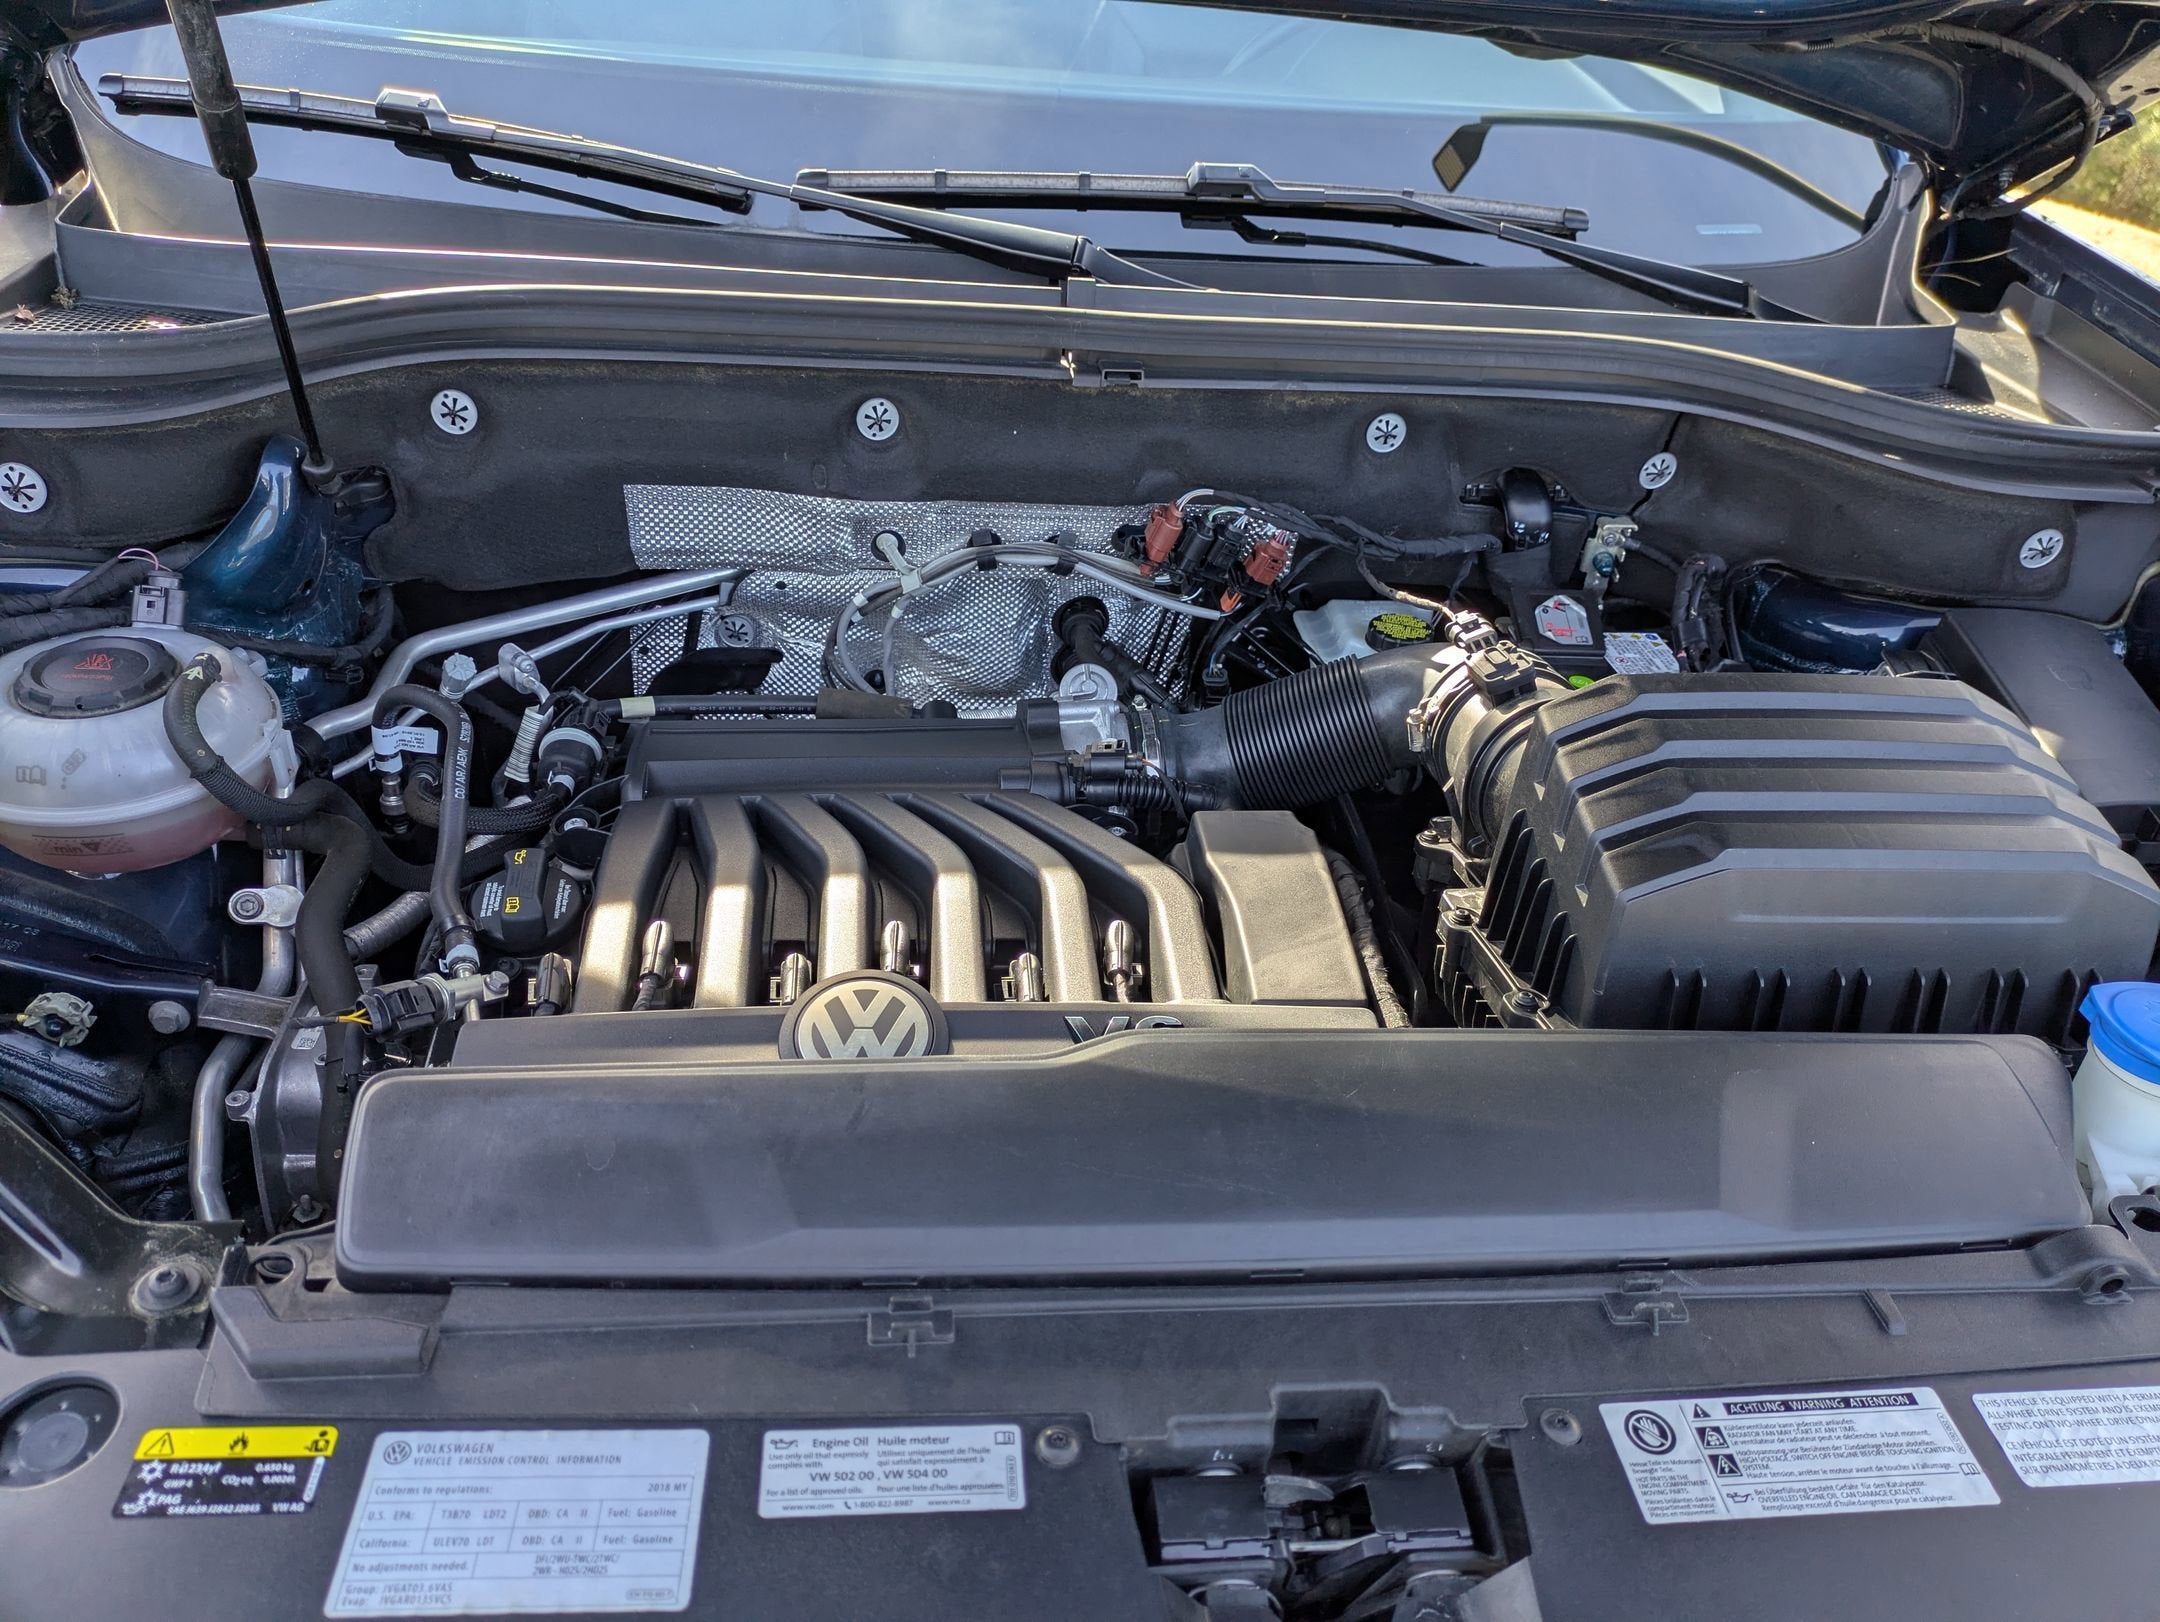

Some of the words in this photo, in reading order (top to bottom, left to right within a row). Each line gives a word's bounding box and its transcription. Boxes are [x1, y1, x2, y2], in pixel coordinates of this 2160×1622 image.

[1731, 1401, 1785, 1414] ACHTUNG
[1789, 1398, 1845, 1410] WARNING
[1851, 1394, 1909, 1408] ATTENTION
[2001, 1398, 2039, 1407] VEHICLE
[2039, 1397, 2049, 1405] IS
[2050, 1395, 2095, 1406] EQUIPPED
[2095, 1394, 2120, 1402] WITH
[1987, 1409, 2038, 1419] ALL-WHEEL
[2038, 1408, 2066, 1417] DRIVE
[2066, 1407, 2100, 1416] SYSTEM
[2102, 1405, 2122, 1414] AND
[2123, 1405, 2133, 1413] IS
[1992, 1422, 2032, 1431] TESTING
[2033, 1421, 2049, 1429] ON
[2049, 1417, 2107, 1428] TWO-WHEEL
[2107, 1416, 2136, 1426] DRIVE
[812, 1438, 850, 1450] Engine
[853, 1437, 868, 1446] Oil
[878, 1437, 906, 1446] Huile
[909, 1436, 950, 1445] moteur
[2006, 1441, 2018, 1450] CE
[2018, 1439, 2063, 1449] VÉHICULE
[2063, 1439, 2078, 1448] EST
[417, 1443, 494, 1454] VOLKSWAGEN
[908, 1448, 954, 1458] uniquement
[956, 1447, 966, 1455] de
[1860, 1449, 1885, 1457] BEFORE
[1887, 1447, 1923, 1456] TOUCHING
[1924, 1446, 1955, 1454] IGNITION
[413, 1456, 452, 1466] VEHICLE
[459, 1456, 505, 1465] EMISSION
[508, 1455, 550, 1465] CONTROL
[557, 1454, 622, 1465] INFORMATION
[785, 1452, 801, 1460] only
[2012, 1452, 2061, 1462] INTÉGRALE
[2060, 1449, 2114, 1460] PERMANENT
[2114, 1449, 2126, 1457] ET
[877, 1459, 890, 1467] qui
[892, 1458, 921, 1466] satisfait
[2020, 1465, 2040, 1475] SUR
[2122, 1459, 2151, 1470] DEUX
[809, 1472, 830, 1482] VW
[834, 1471, 855, 1481] 502
[858, 1470, 874, 1480] 00
[883, 1469, 904, 1479] VW
[907, 1468, 928, 1479] 504
[931, 1468, 948, 1478] 00
[375, 1485, 419, 1496] Conforms
[422, 1486, 432, 1495] to
[435, 1485, 493, 1496] regulations:
[648, 1482, 671, 1492] 2018
[674, 1482, 688, 1492] MY
[766, 1488, 778, 1496] For
[800, 1487, 808, 1495] of
[810, 1487, 847, 1496] approved
[912, 1484, 928, 1492] liste
[1857, 1489, 1888, 1497] DAMAGE
[157, 1493, 182, 1505] PAG
[273, 1502, 289, 1512] VW
[290, 1502, 305, 1512] AG
[368, 1509, 386, 1521] U.S.
[393, 1510, 415, 1521] EPA:
[483, 1509, 507, 1519] LDT2
[528, 1508, 550, 1519] OBD:
[556, 1508, 568, 1519] CA
[608, 1507, 630, 1518] Fuel:
[637, 1507, 677, 1518] Gasoline
[359, 1538, 410, 1550] California:
[433, 1536, 470, 1547] ULEV70
[476, 1536, 495, 1547] LDT
[522, 1535, 545, 1546] OBD:
[551, 1535, 564, 1546] CA
[603, 1535, 626, 1545] Fuel:
[633, 1534, 674, 1545] Gasoline
[352, 1563, 365, 1573] No
[368, 1563, 428, 1574] adjustments
[431, 1560, 469, 1571] needed.
